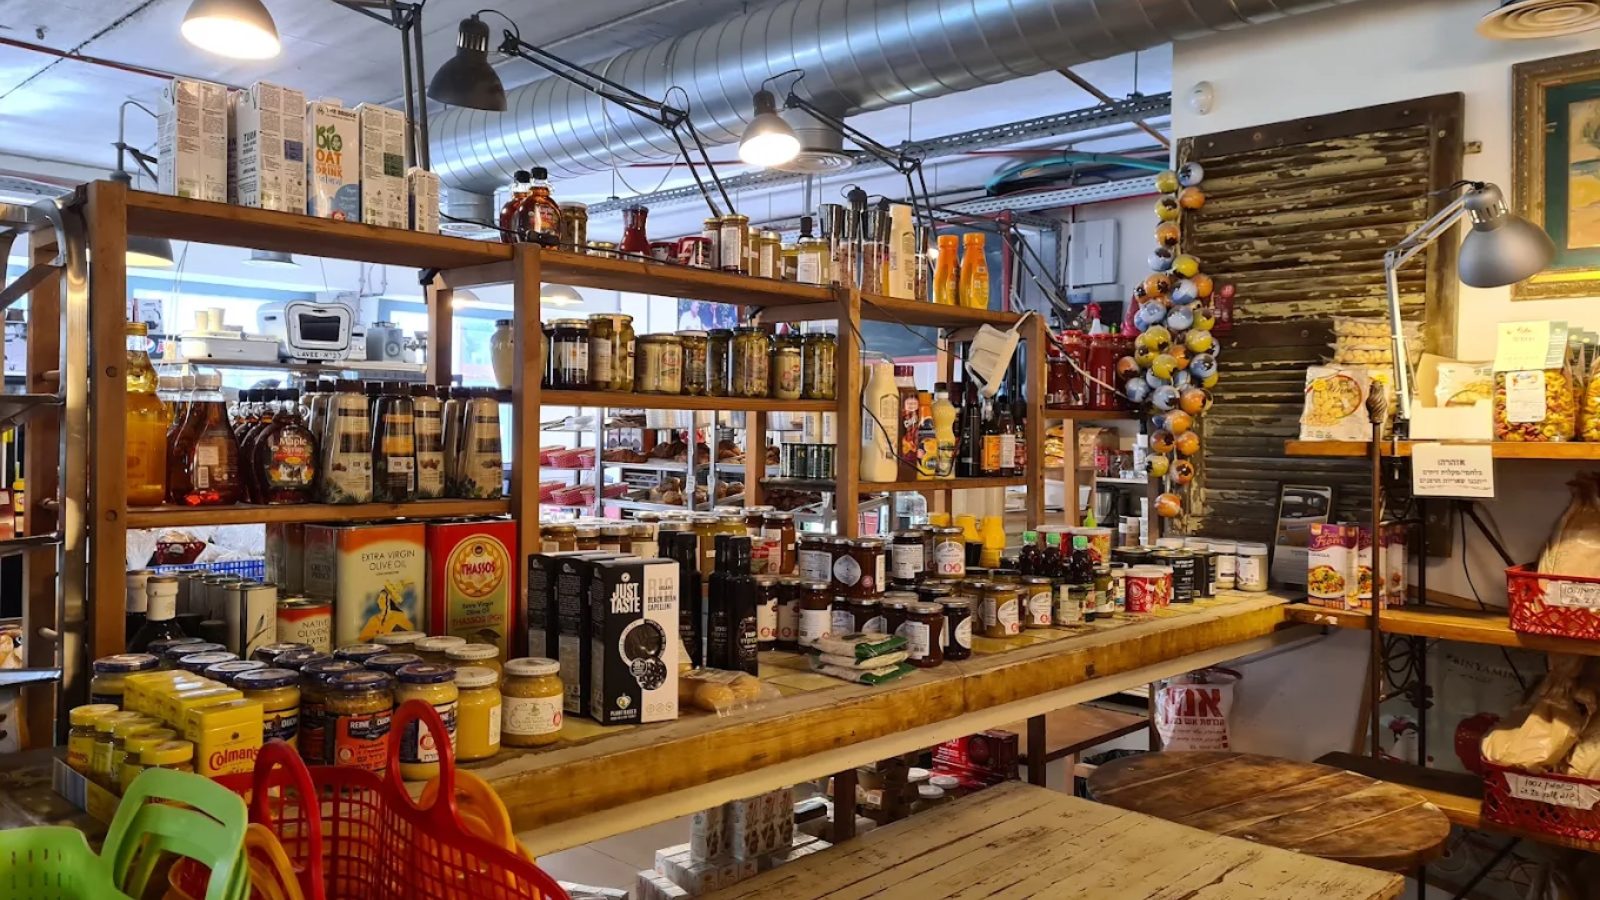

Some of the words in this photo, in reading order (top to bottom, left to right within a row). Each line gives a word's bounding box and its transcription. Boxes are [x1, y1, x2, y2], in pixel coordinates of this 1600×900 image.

[315, 150, 342, 166] OAT
[315, 165, 343, 178] DRINK
[279, 435, 307, 447] Maple
[361, 552, 386, 562] EXTRA
[387, 548, 415, 560] VIRGIN
[368, 561, 393, 572] OLIVE
[394, 559, 407, 570] OIL
[461, 561, 496, 575] THASSOS
[614, 583, 639, 597] JUST
[610, 596, 640, 613] TASTE
[209, 746, 260, 771] Colman's
